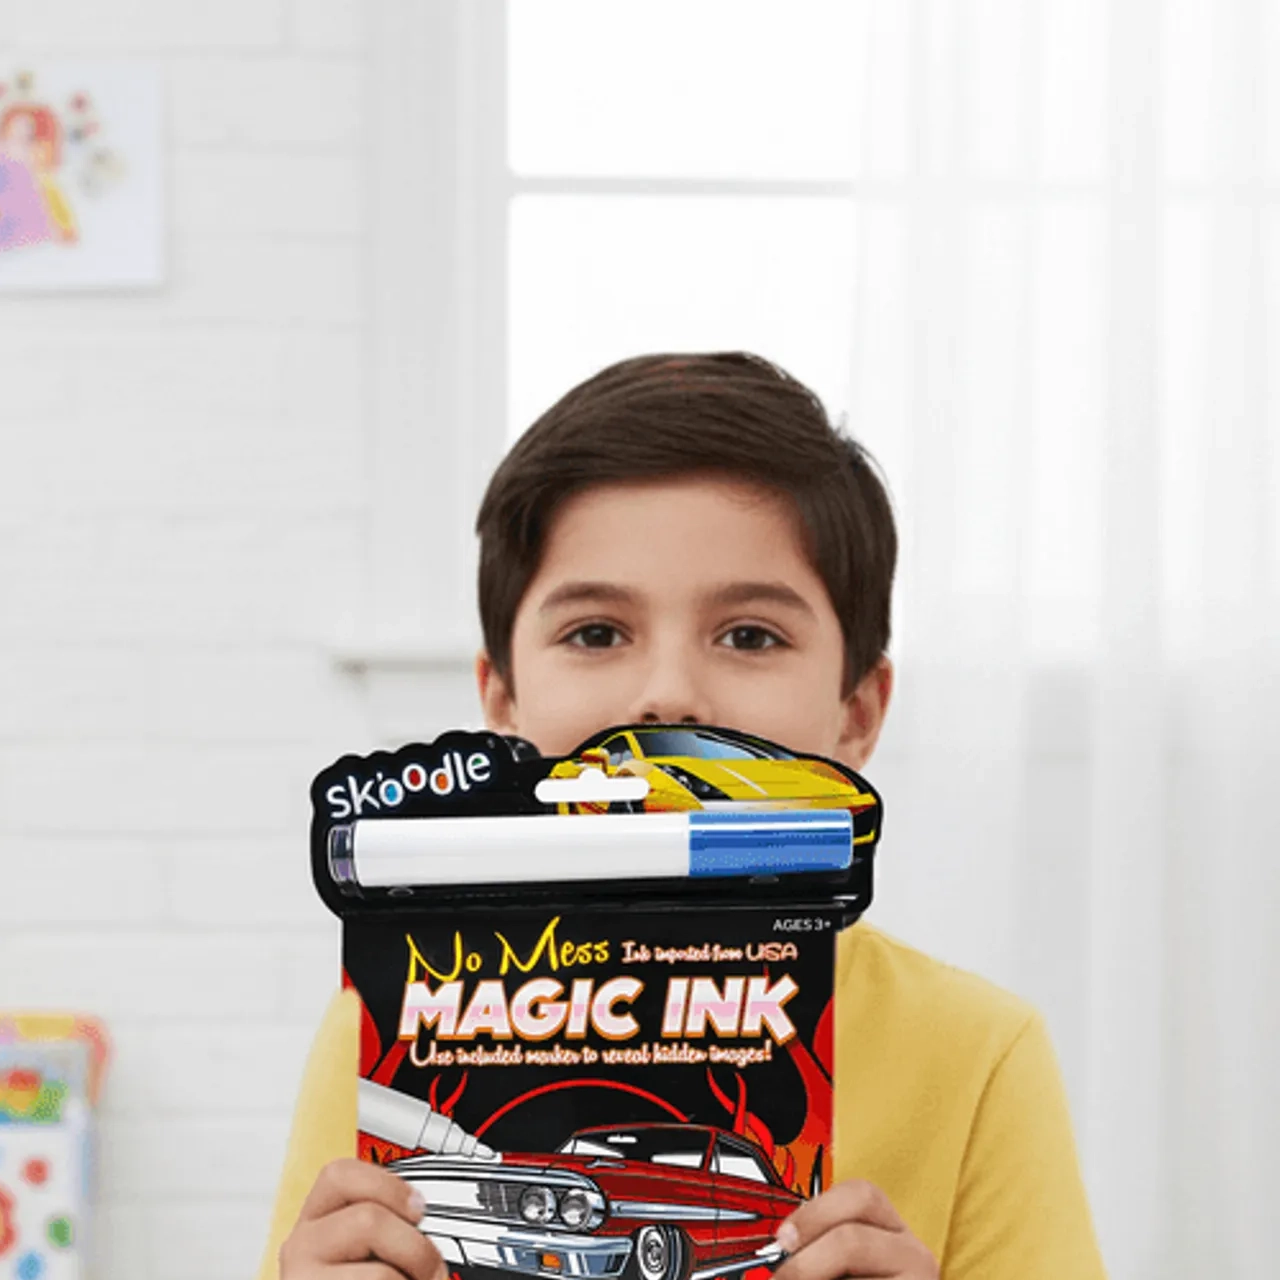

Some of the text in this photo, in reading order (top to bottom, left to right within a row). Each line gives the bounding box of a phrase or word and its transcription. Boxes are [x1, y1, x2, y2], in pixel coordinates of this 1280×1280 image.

[773, 919, 831, 931] AGES 3+
[406, 916, 609, 984] No Mess
[746, 941, 798, 962] USA
[399, 973, 799, 1046] MAGIC INK
[409, 1038, 773, 1068] Use included marker to reveal hidden images!
